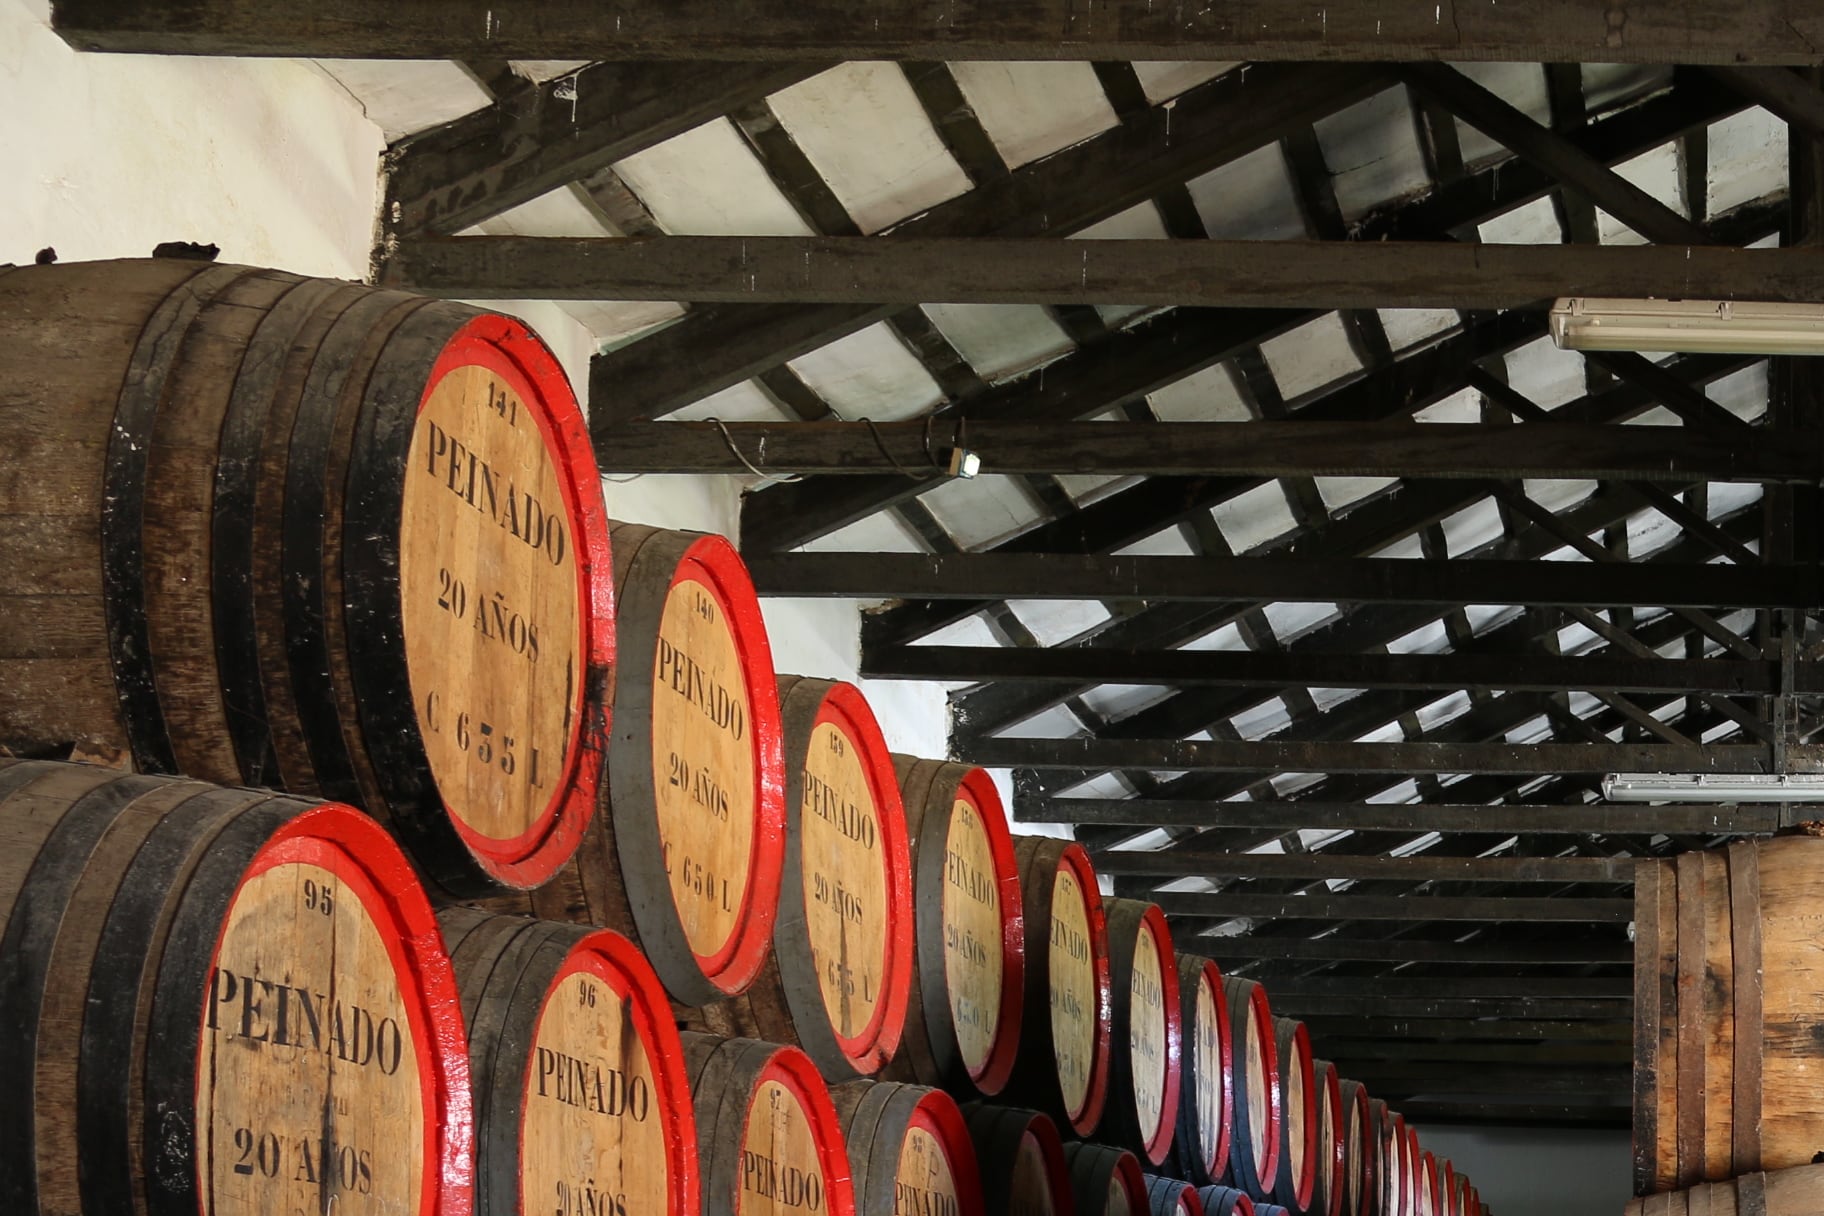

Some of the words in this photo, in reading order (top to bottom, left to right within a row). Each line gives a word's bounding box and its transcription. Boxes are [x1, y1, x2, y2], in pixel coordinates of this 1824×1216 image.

[488, 382, 516, 427] 141
[427, 419, 564, 567] PEINADO
[438, 567, 465, 620] 20
[474, 592, 539, 664] AÑOS
[695, 591, 715, 625] 140
[657, 636, 743, 741] PEINADO
[427, 690, 440, 733] C
[528, 758, 544, 790] L
[669, 751, 688, 792] 20
[694, 766, 729, 822] AÑOS
[804, 769, 874, 850] PEINADO
[304, 879, 334, 916] 95
[722, 879, 732, 912] L
[814, 871, 829, 904] 20
[947, 848, 994, 911] EINADO
[206, 966, 401, 1077] PEINADO
[579, 981, 596, 1008] 96
[536, 1046, 649, 1122] PEINADO
[234, 1127, 282, 1179] 20
[743, 1150, 821, 1211] PEINADO
